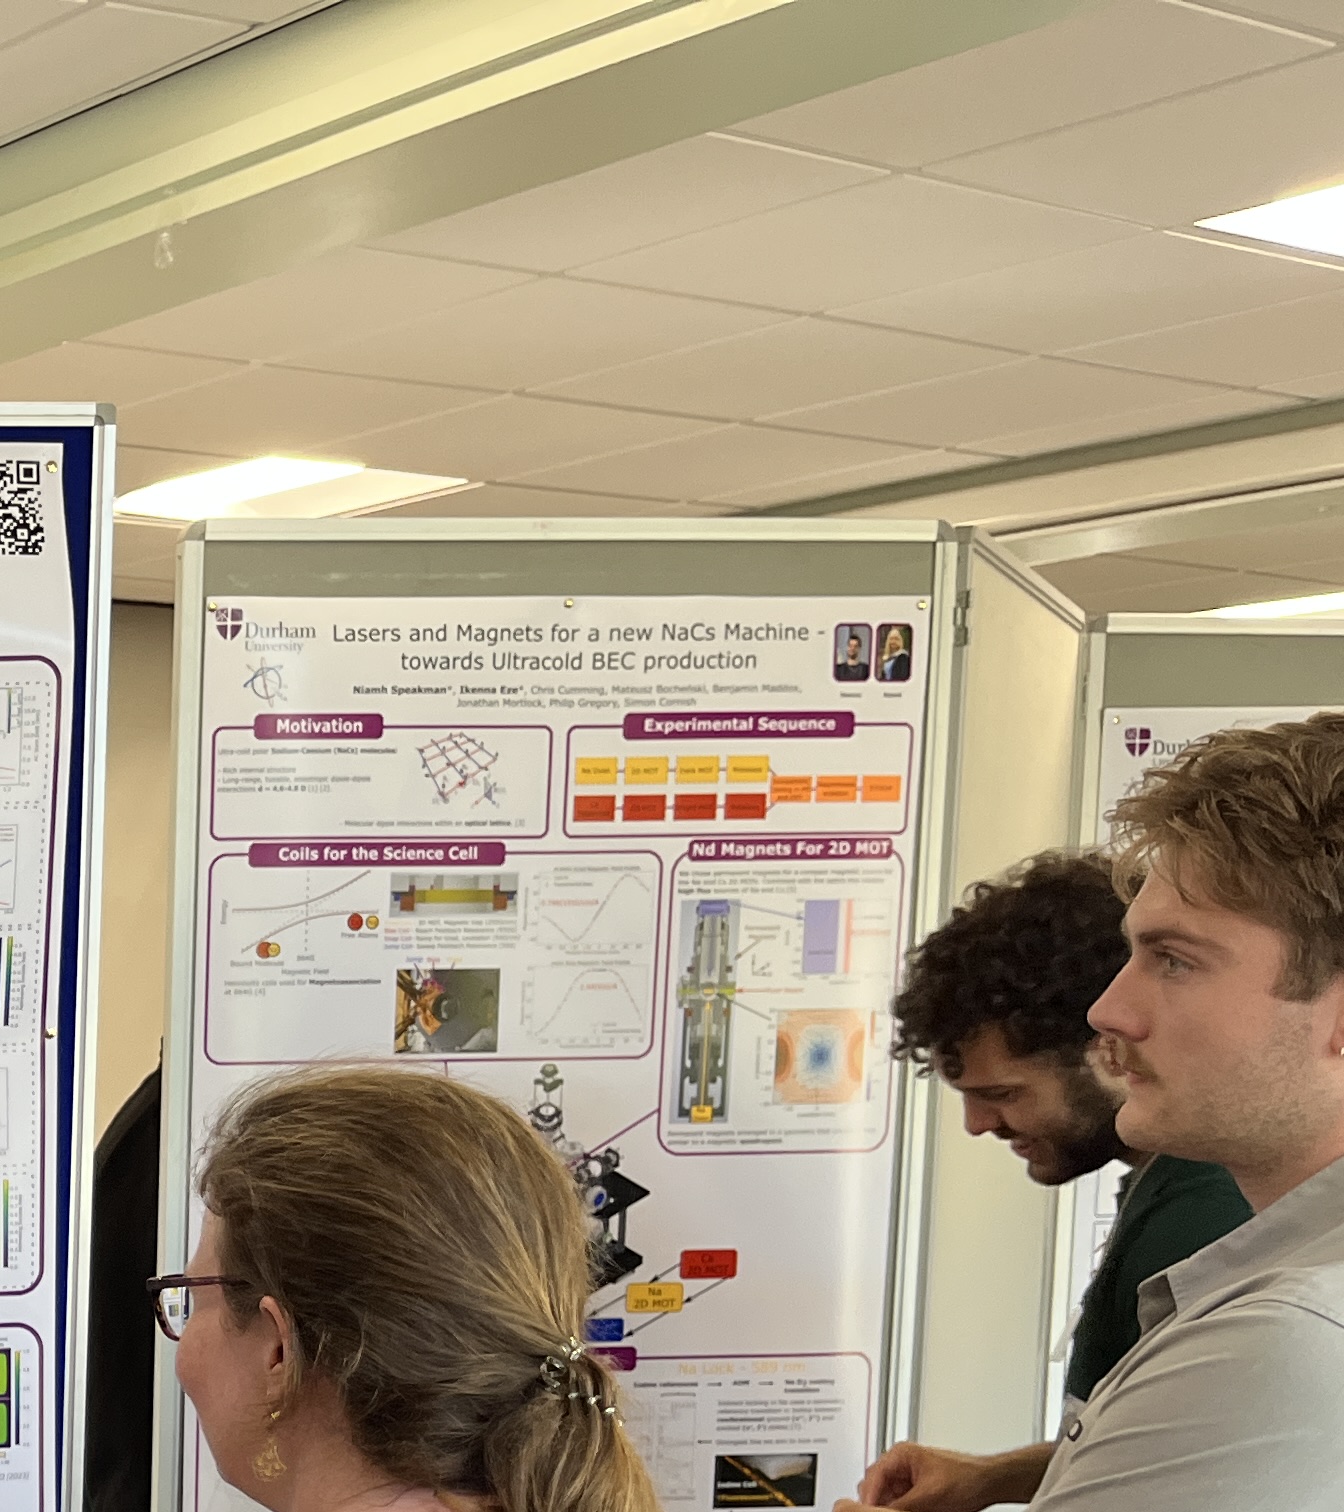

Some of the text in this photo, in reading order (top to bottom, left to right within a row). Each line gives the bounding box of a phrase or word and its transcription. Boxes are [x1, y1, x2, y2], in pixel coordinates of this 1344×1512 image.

[245, 621, 316, 638] Durham
[333, 622, 808, 646] Lasers and Magnets for a new NaCs Machine
[401, 650, 756, 673] towards Ultracold BEC production
[276, 717, 362, 733] Motivation
[643, 716, 835, 734] Experimental Sequence
[278, 845, 477, 861] Coils for the Science Cell
[692, 841, 889, 859] Nd Magnets For 2D MOT
[652, 1299, 675, 1308] MOT
